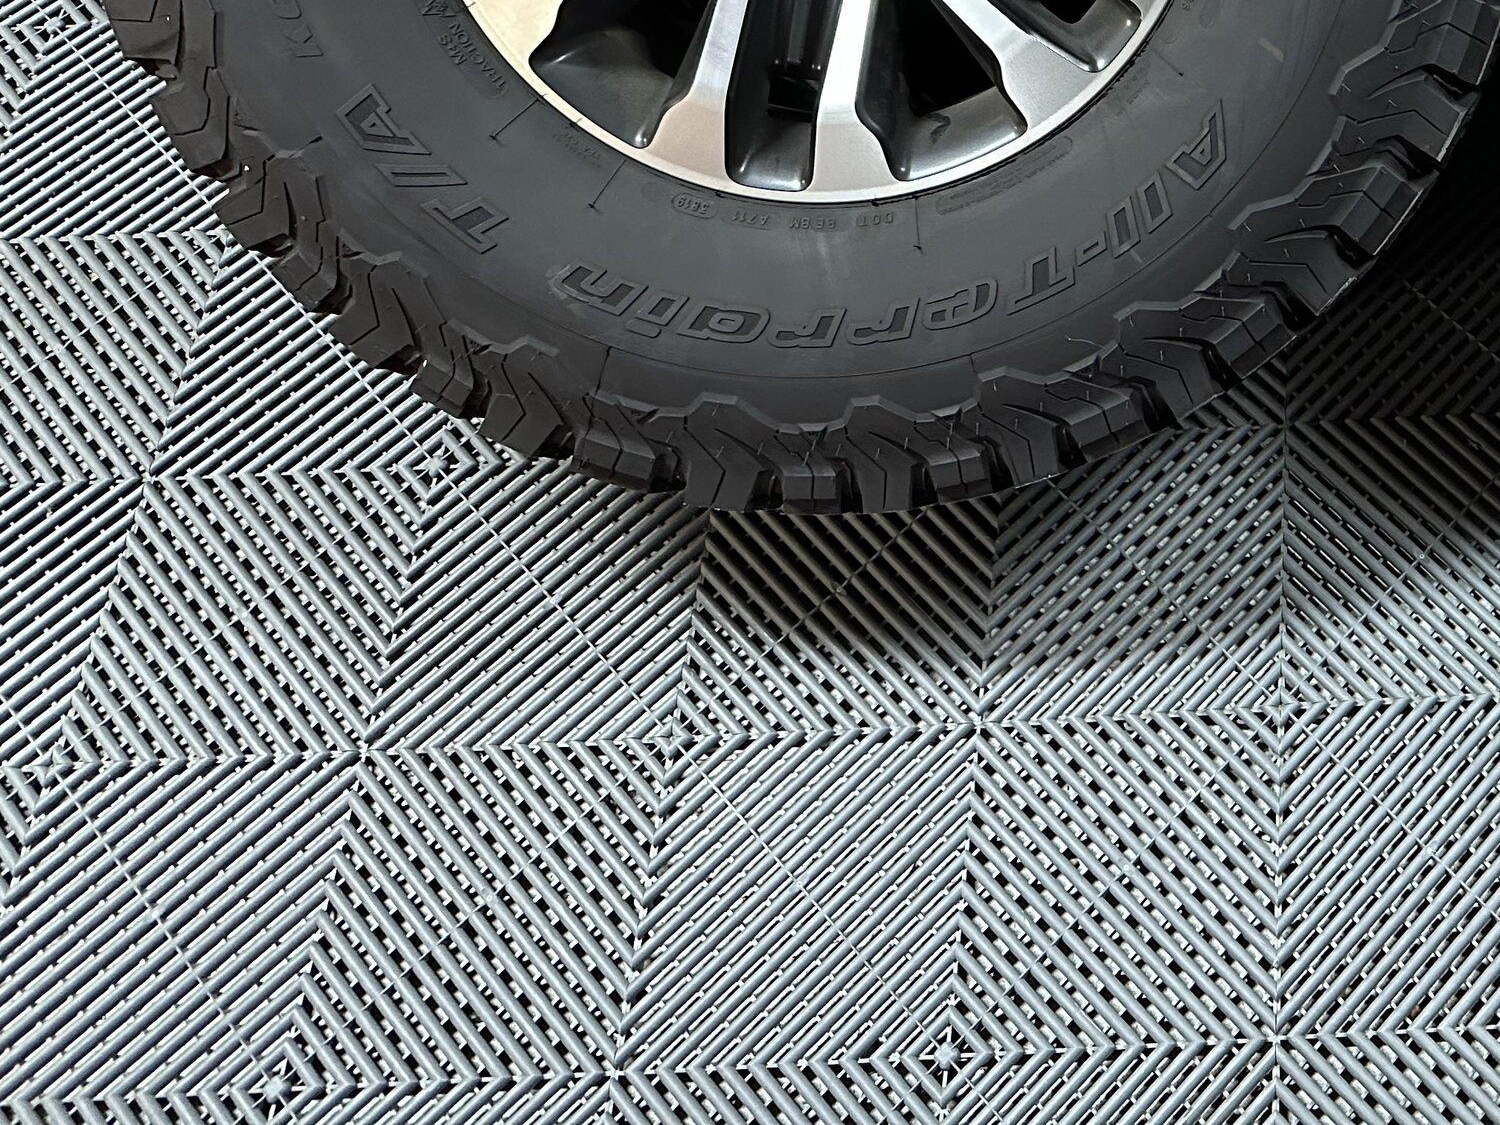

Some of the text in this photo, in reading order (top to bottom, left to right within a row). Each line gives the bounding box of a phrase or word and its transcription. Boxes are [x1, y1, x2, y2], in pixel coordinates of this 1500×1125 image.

[449, 21, 506, 89] TRACTION
[335, 83, 512, 255] T/A
[554, 99, 1227, 348] All-Terrain
[857, 210, 894, 228] DOT
